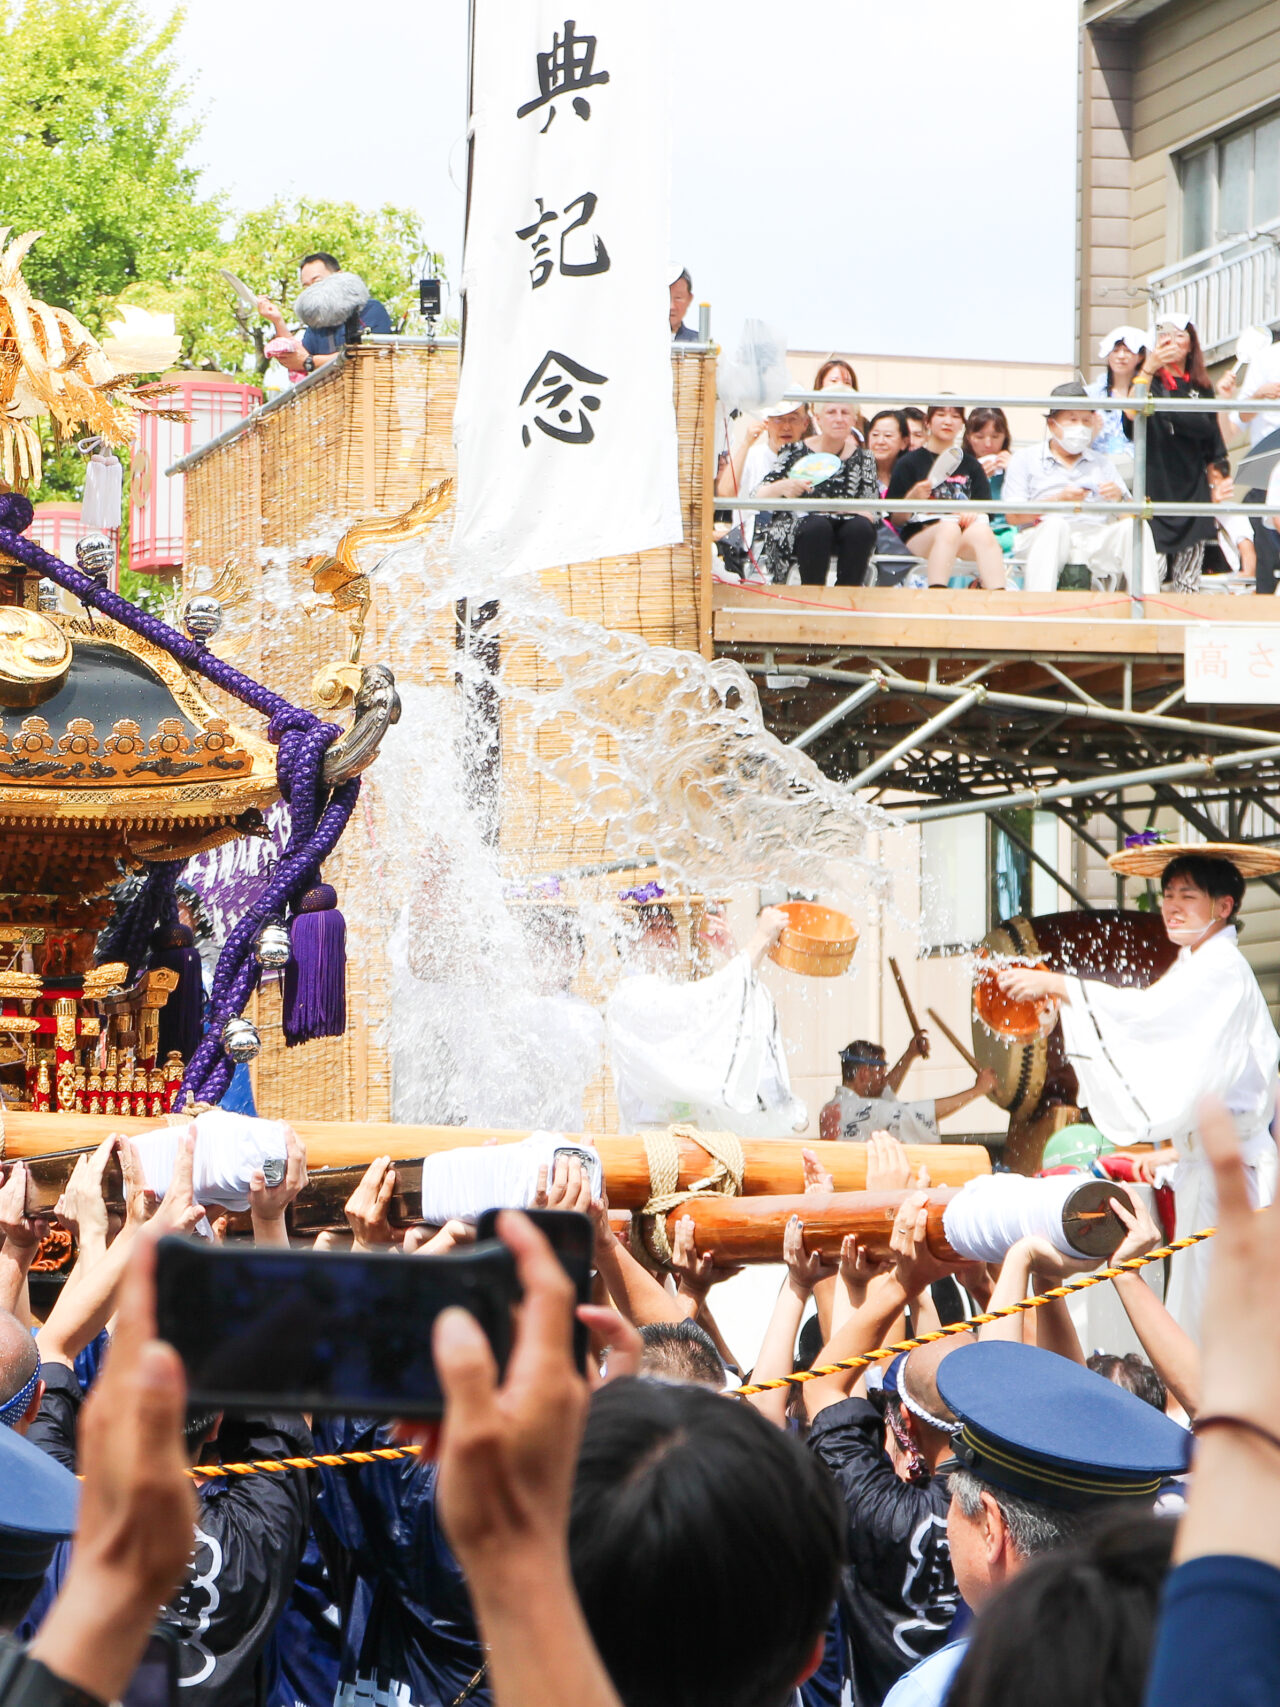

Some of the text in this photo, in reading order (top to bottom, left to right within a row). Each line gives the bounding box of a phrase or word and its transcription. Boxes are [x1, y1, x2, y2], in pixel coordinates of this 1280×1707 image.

[516, 19, 611, 449] 典記念
[1194, 641, 1275, 679] 高さ
